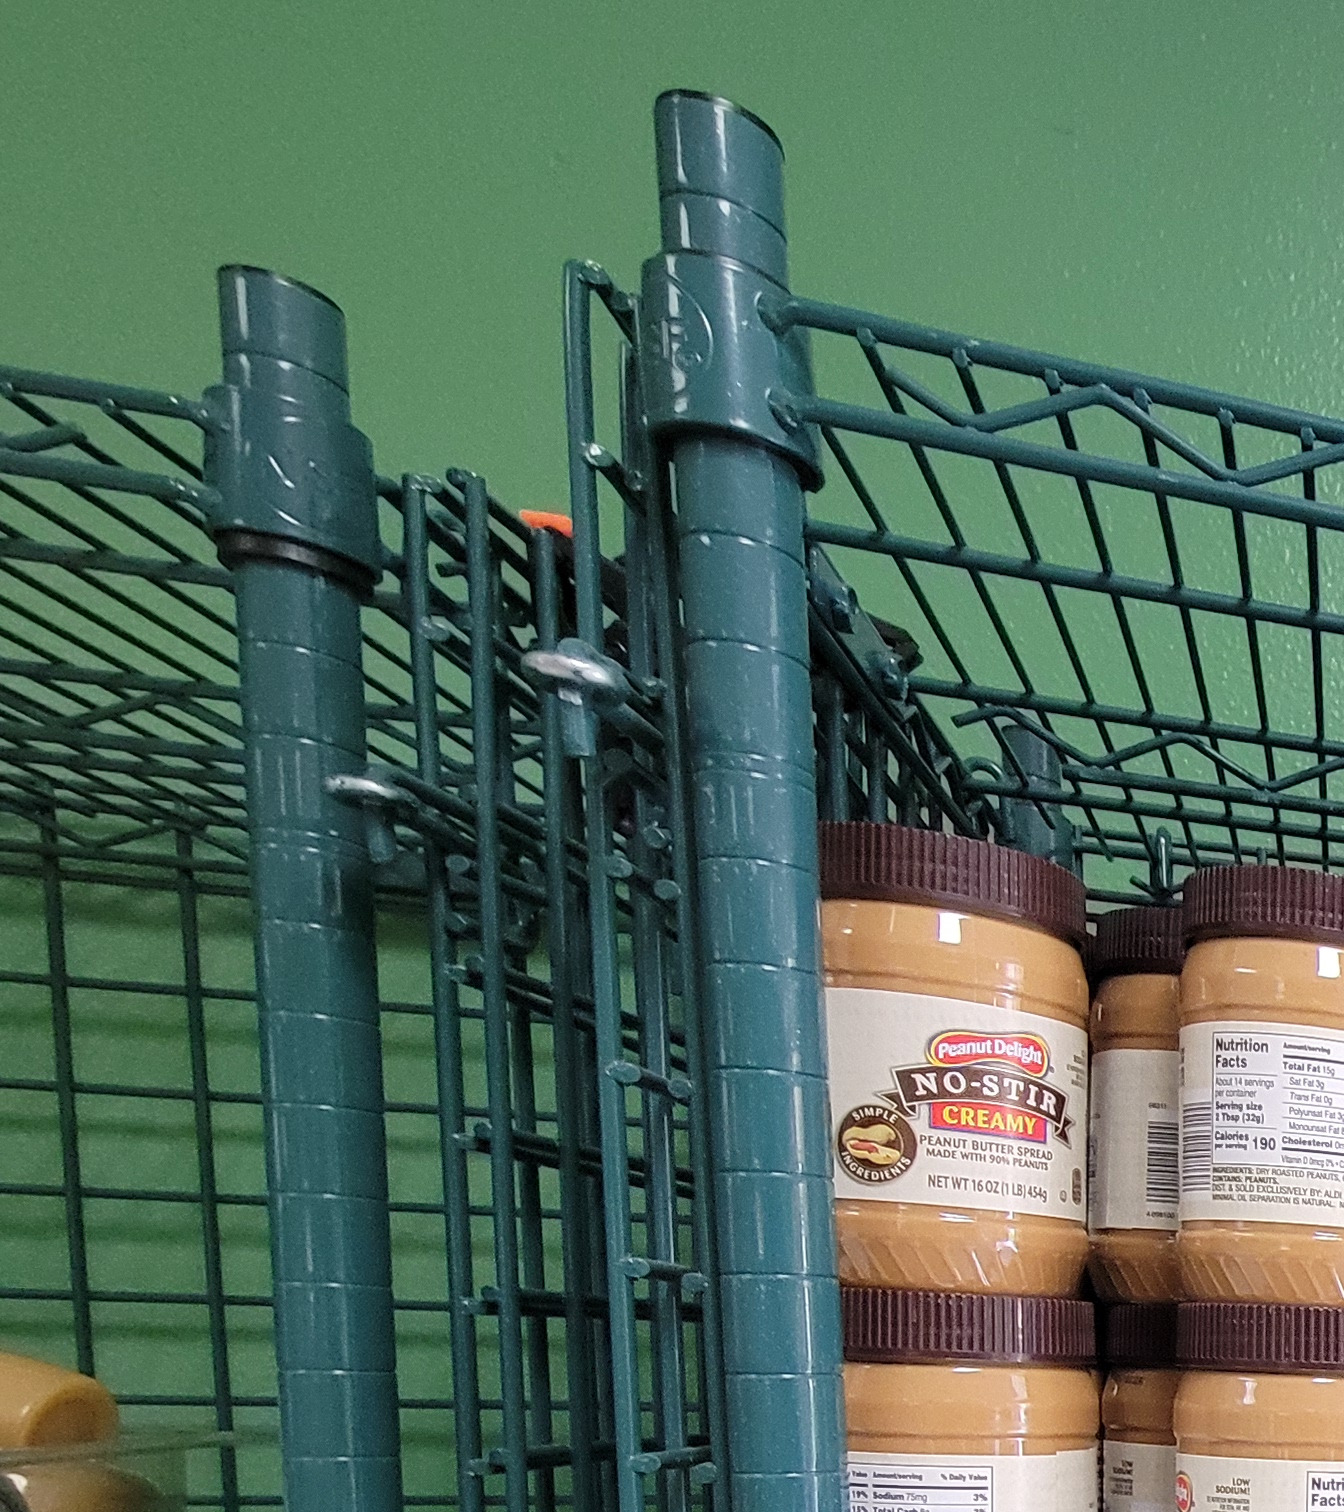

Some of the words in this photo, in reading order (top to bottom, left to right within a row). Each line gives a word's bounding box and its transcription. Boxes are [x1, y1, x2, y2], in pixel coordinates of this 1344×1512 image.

[938, 1039, 993, 1059] Peanut
[994, 1038, 1043, 1064] Delight
[1216, 1038, 1268, 1053] Nutrition
[1216, 1055, 1247, 1068] Facts
[1283, 1062, 1304, 1071] Total
[1307, 1063, 1321, 1073] Fat
[911, 1071, 1057, 1116] NO-STIR
[852, 1105, 898, 1124] SIMPLE
[1216, 1102, 1243, 1112] Serving
[1246, 1103, 1263, 1111] size
[943, 1105, 1037, 1135] CREAMY
[919, 1134, 967, 1148] PEANUT
[972, 1140, 1014, 1155] BUTTER
[1017, 1146, 1053, 1160] SPREAD
[1215, 1131, 1249, 1141] Calories
[1253, 1137, 1275, 1150] 190
[841, 1150, 911, 1181] INGREDIENTS
[926, 1148, 958, 1160] MADE
[961, 1152, 986, 1163] WITH
[989, 1154, 1010, 1165] 90%
[1013, 1158, 1048, 1171] PEANUTS
[928, 1175, 949, 1188] NET
[951, 1177, 970, 1191] WT
[972, 1180, 983, 1192] 16
[985, 1180, 1000, 1194] OZ
[1011, 1184, 1026, 1198] LB)
[1027, 1186, 1047, 1203] 454g
[1216, 1486, 1250, 1495] SODIUM!
[1232, 1478, 1250, 1486] LOW
[873, 1492, 904, 1500] Sodium
[973, 1493, 987, 1502] 3%
